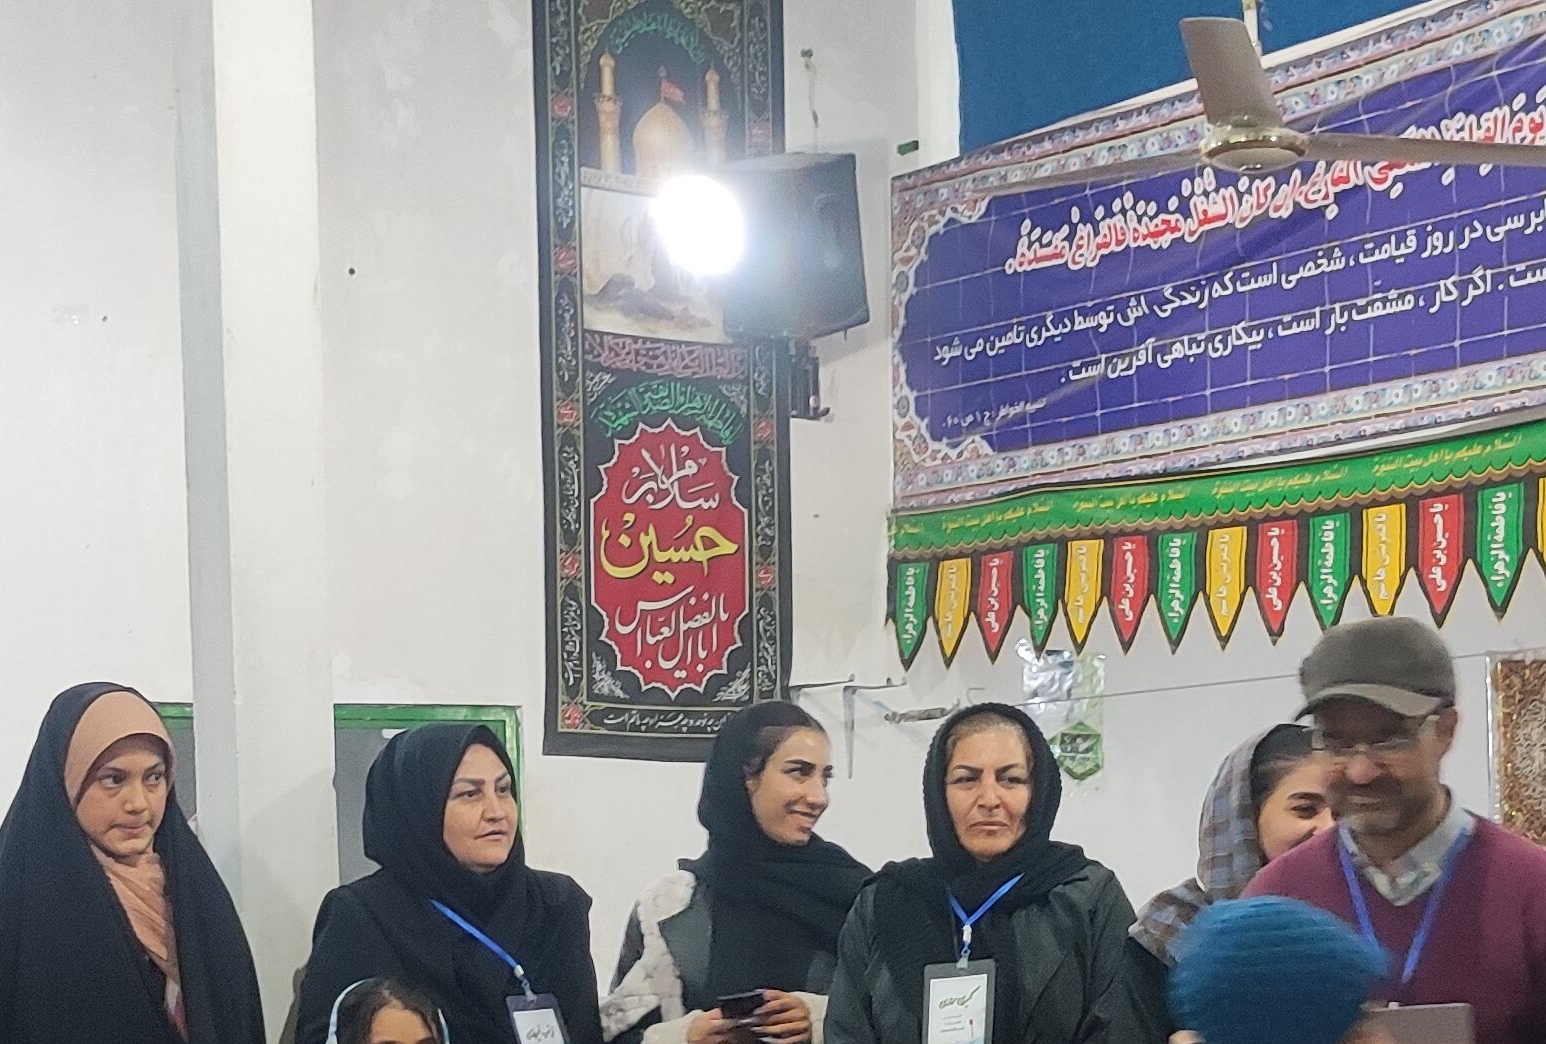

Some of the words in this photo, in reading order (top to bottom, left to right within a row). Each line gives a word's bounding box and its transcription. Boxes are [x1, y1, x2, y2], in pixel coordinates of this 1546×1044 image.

[1421, 226, 1454, 260] روز
[1460, 219, 1483, 249] در
[1236, 262, 1278, 294] است
[1280, 247, 1346, 287] شخصی
[1153, 278, 1210, 319] زندگی
[1212, 271, 1235, 297] که
[1429, 278, 1460, 313] کار
[1464, 269, 1493, 306] اگر
[1074, 301, 1115, 332] توسط
[1118, 295, 1149, 327] اش
[1324, 305, 1349, 335] بار
[1026, 314, 1072, 349] دیگری
[1207, 321, 1265, 359] بیکاری
[933, 340, 963, 366] شود
[961, 338, 986, 361] می
[1107, 338, 1156, 379] آفرین
[1156, 336, 1205, 367] تباهی
